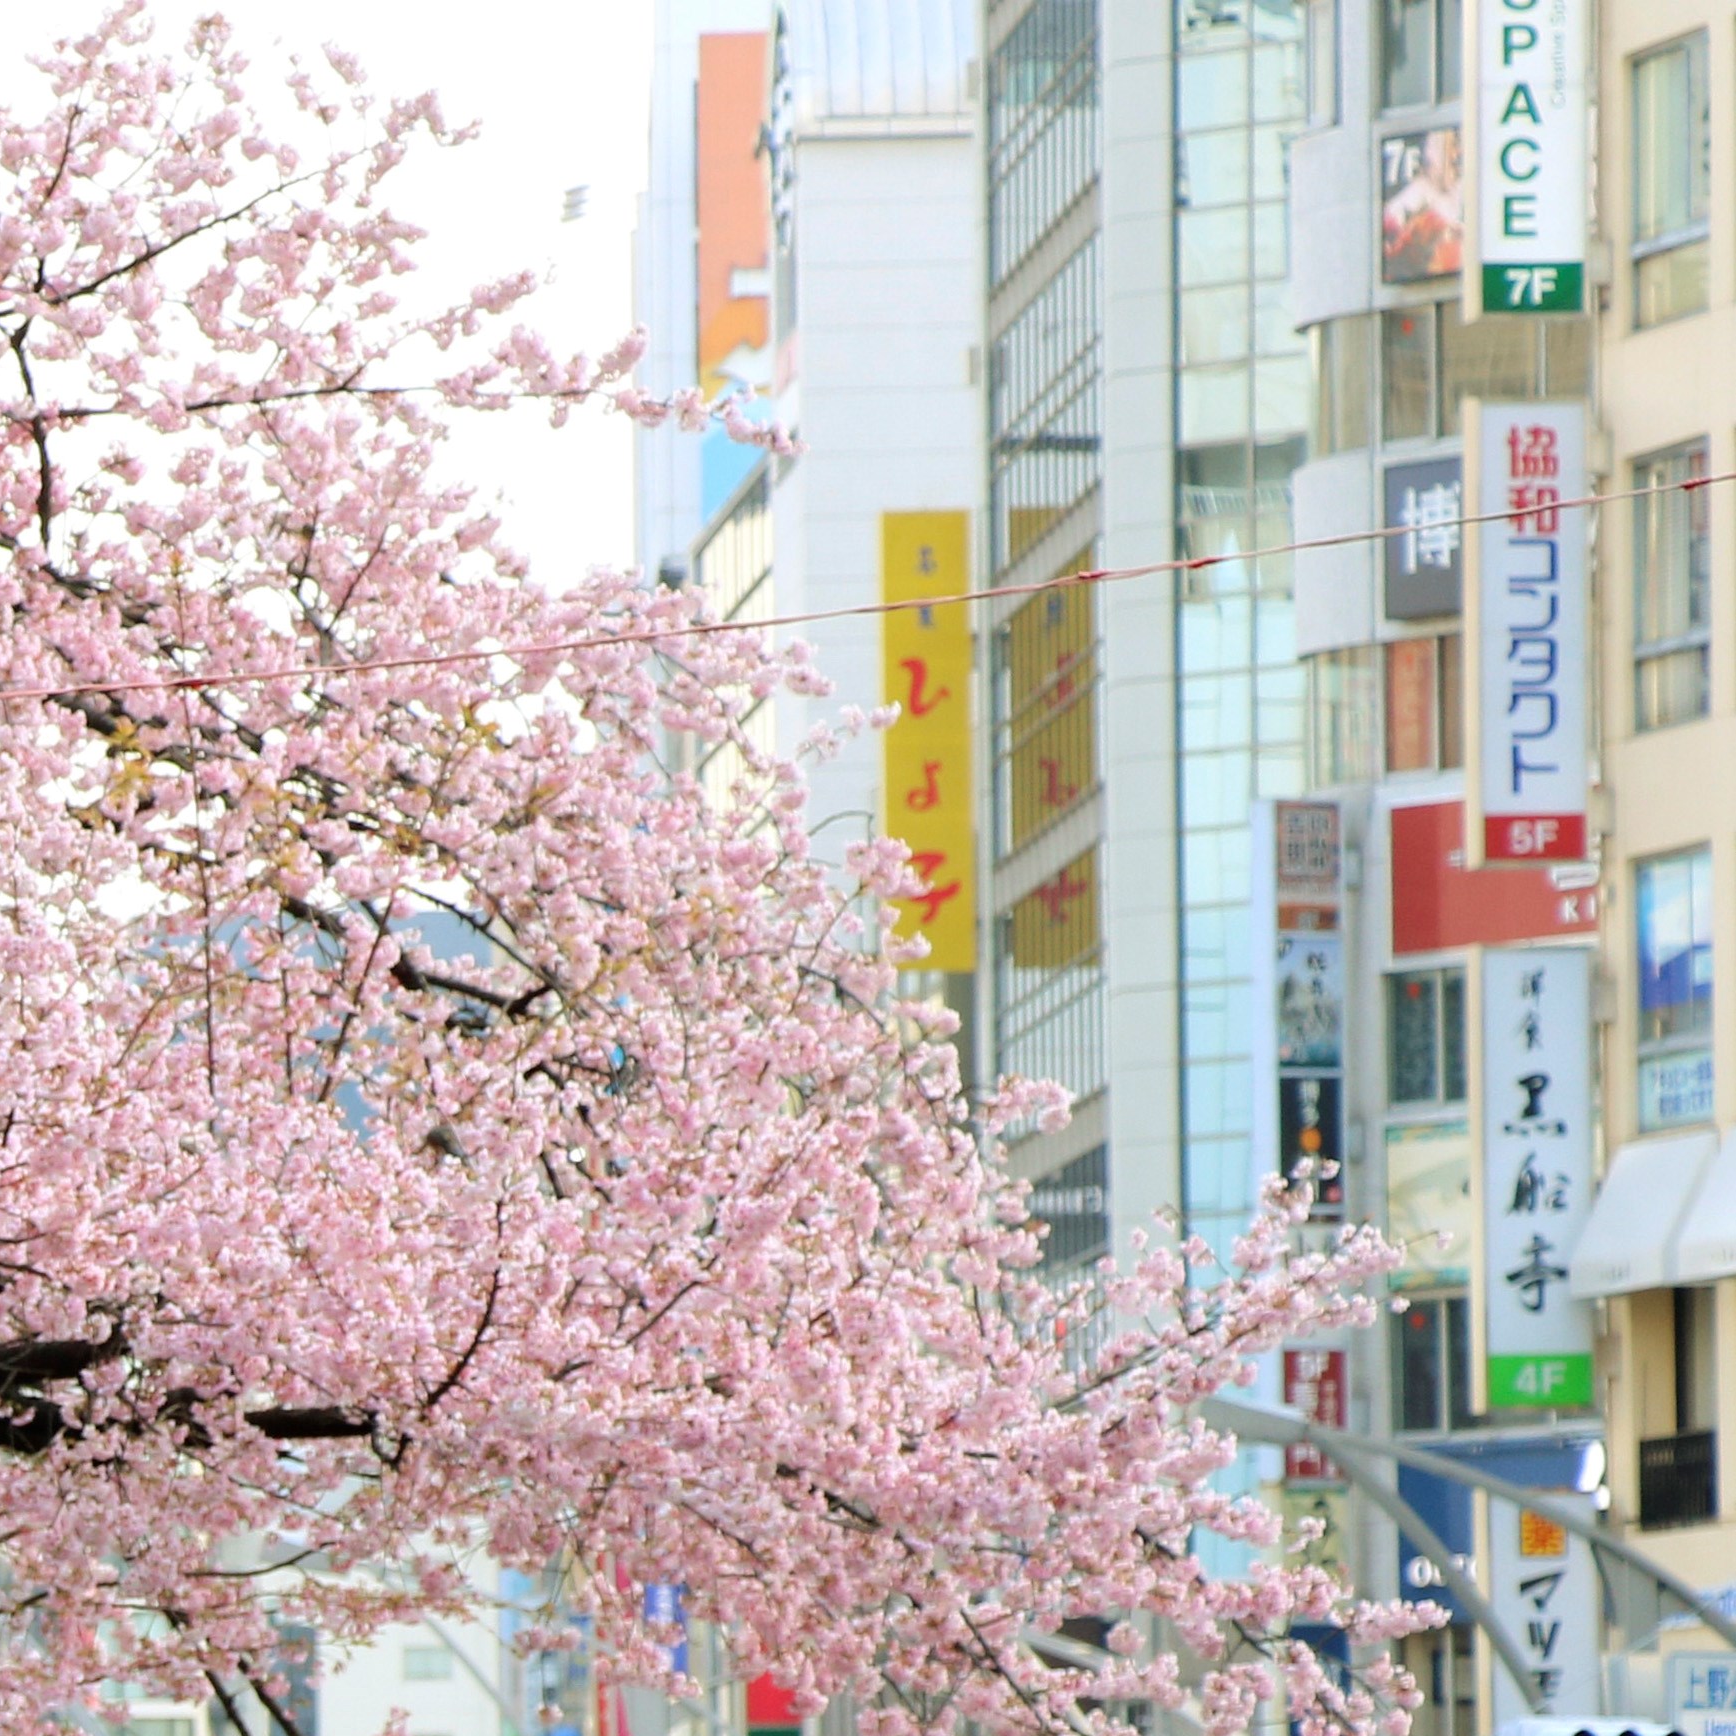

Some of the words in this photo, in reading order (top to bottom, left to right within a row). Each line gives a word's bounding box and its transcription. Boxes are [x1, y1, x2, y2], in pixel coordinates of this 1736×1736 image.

[1499, 0, 1542, 238] PACE
[1505, 267, 1558, 305] 7F
[1508, 424, 1559, 794] 協和コンタクト
[1510, 820, 1559, 854] 5F
[1514, 1361, 1567, 1395] 4F
[1683, 1667, 1736, 1710] 上野
